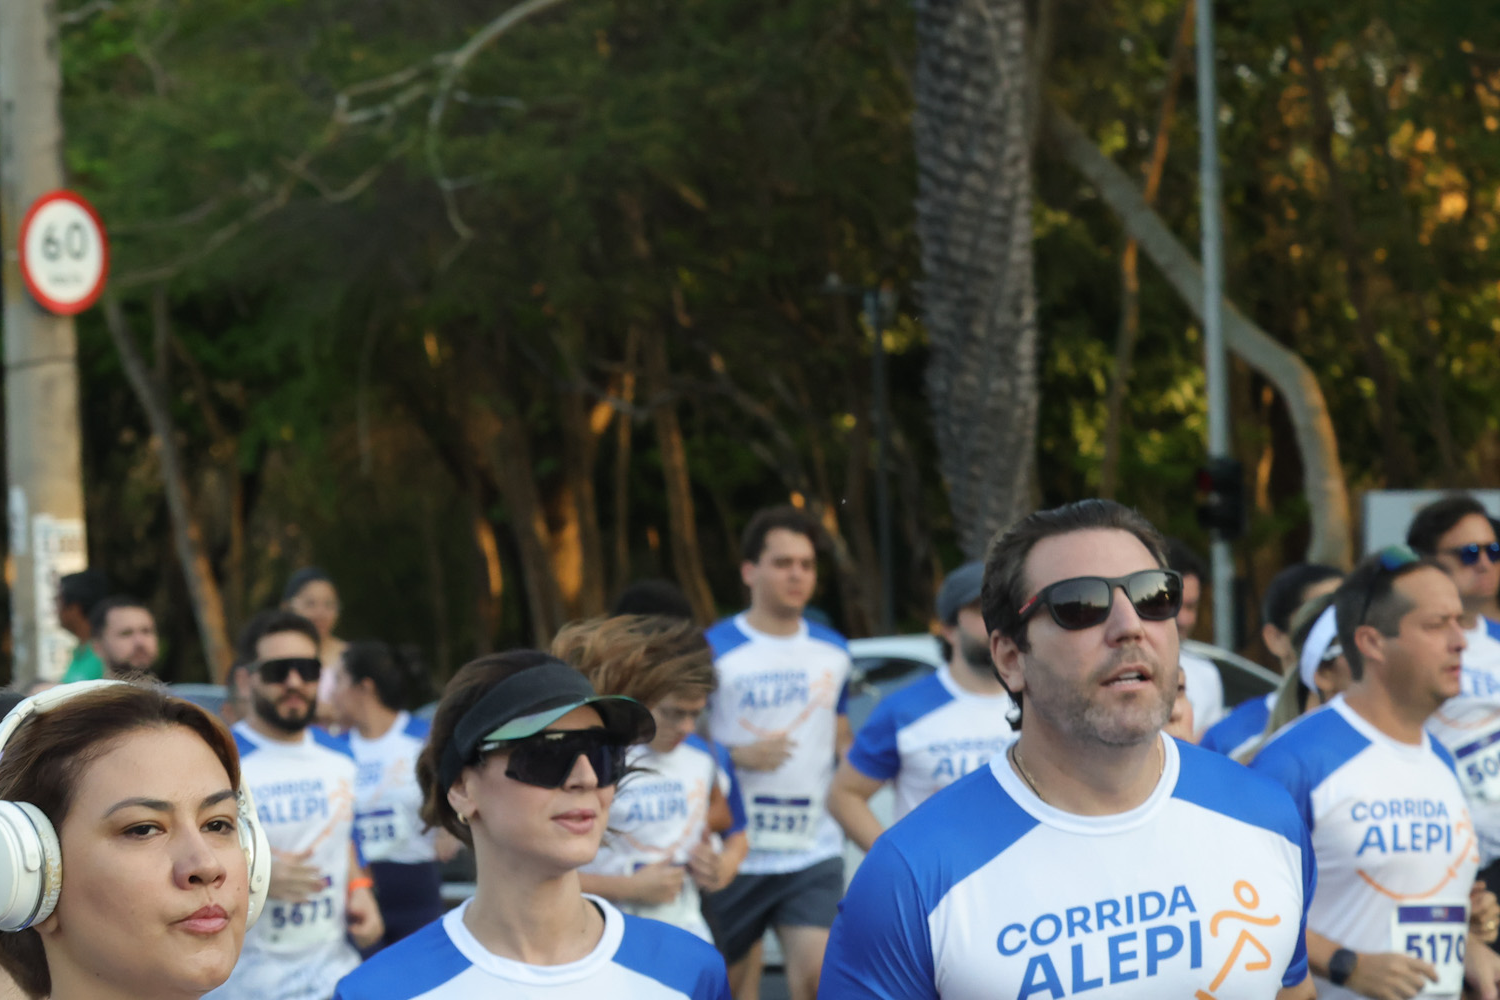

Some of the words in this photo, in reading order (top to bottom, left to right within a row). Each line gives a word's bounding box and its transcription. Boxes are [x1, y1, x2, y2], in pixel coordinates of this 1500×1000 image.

[41, 221, 88, 262] 60
[1350, 798, 1450, 822] CORRIDA
[1355, 822, 1452, 857] ALEPI
[996, 885, 1197, 957] CORRIDA
